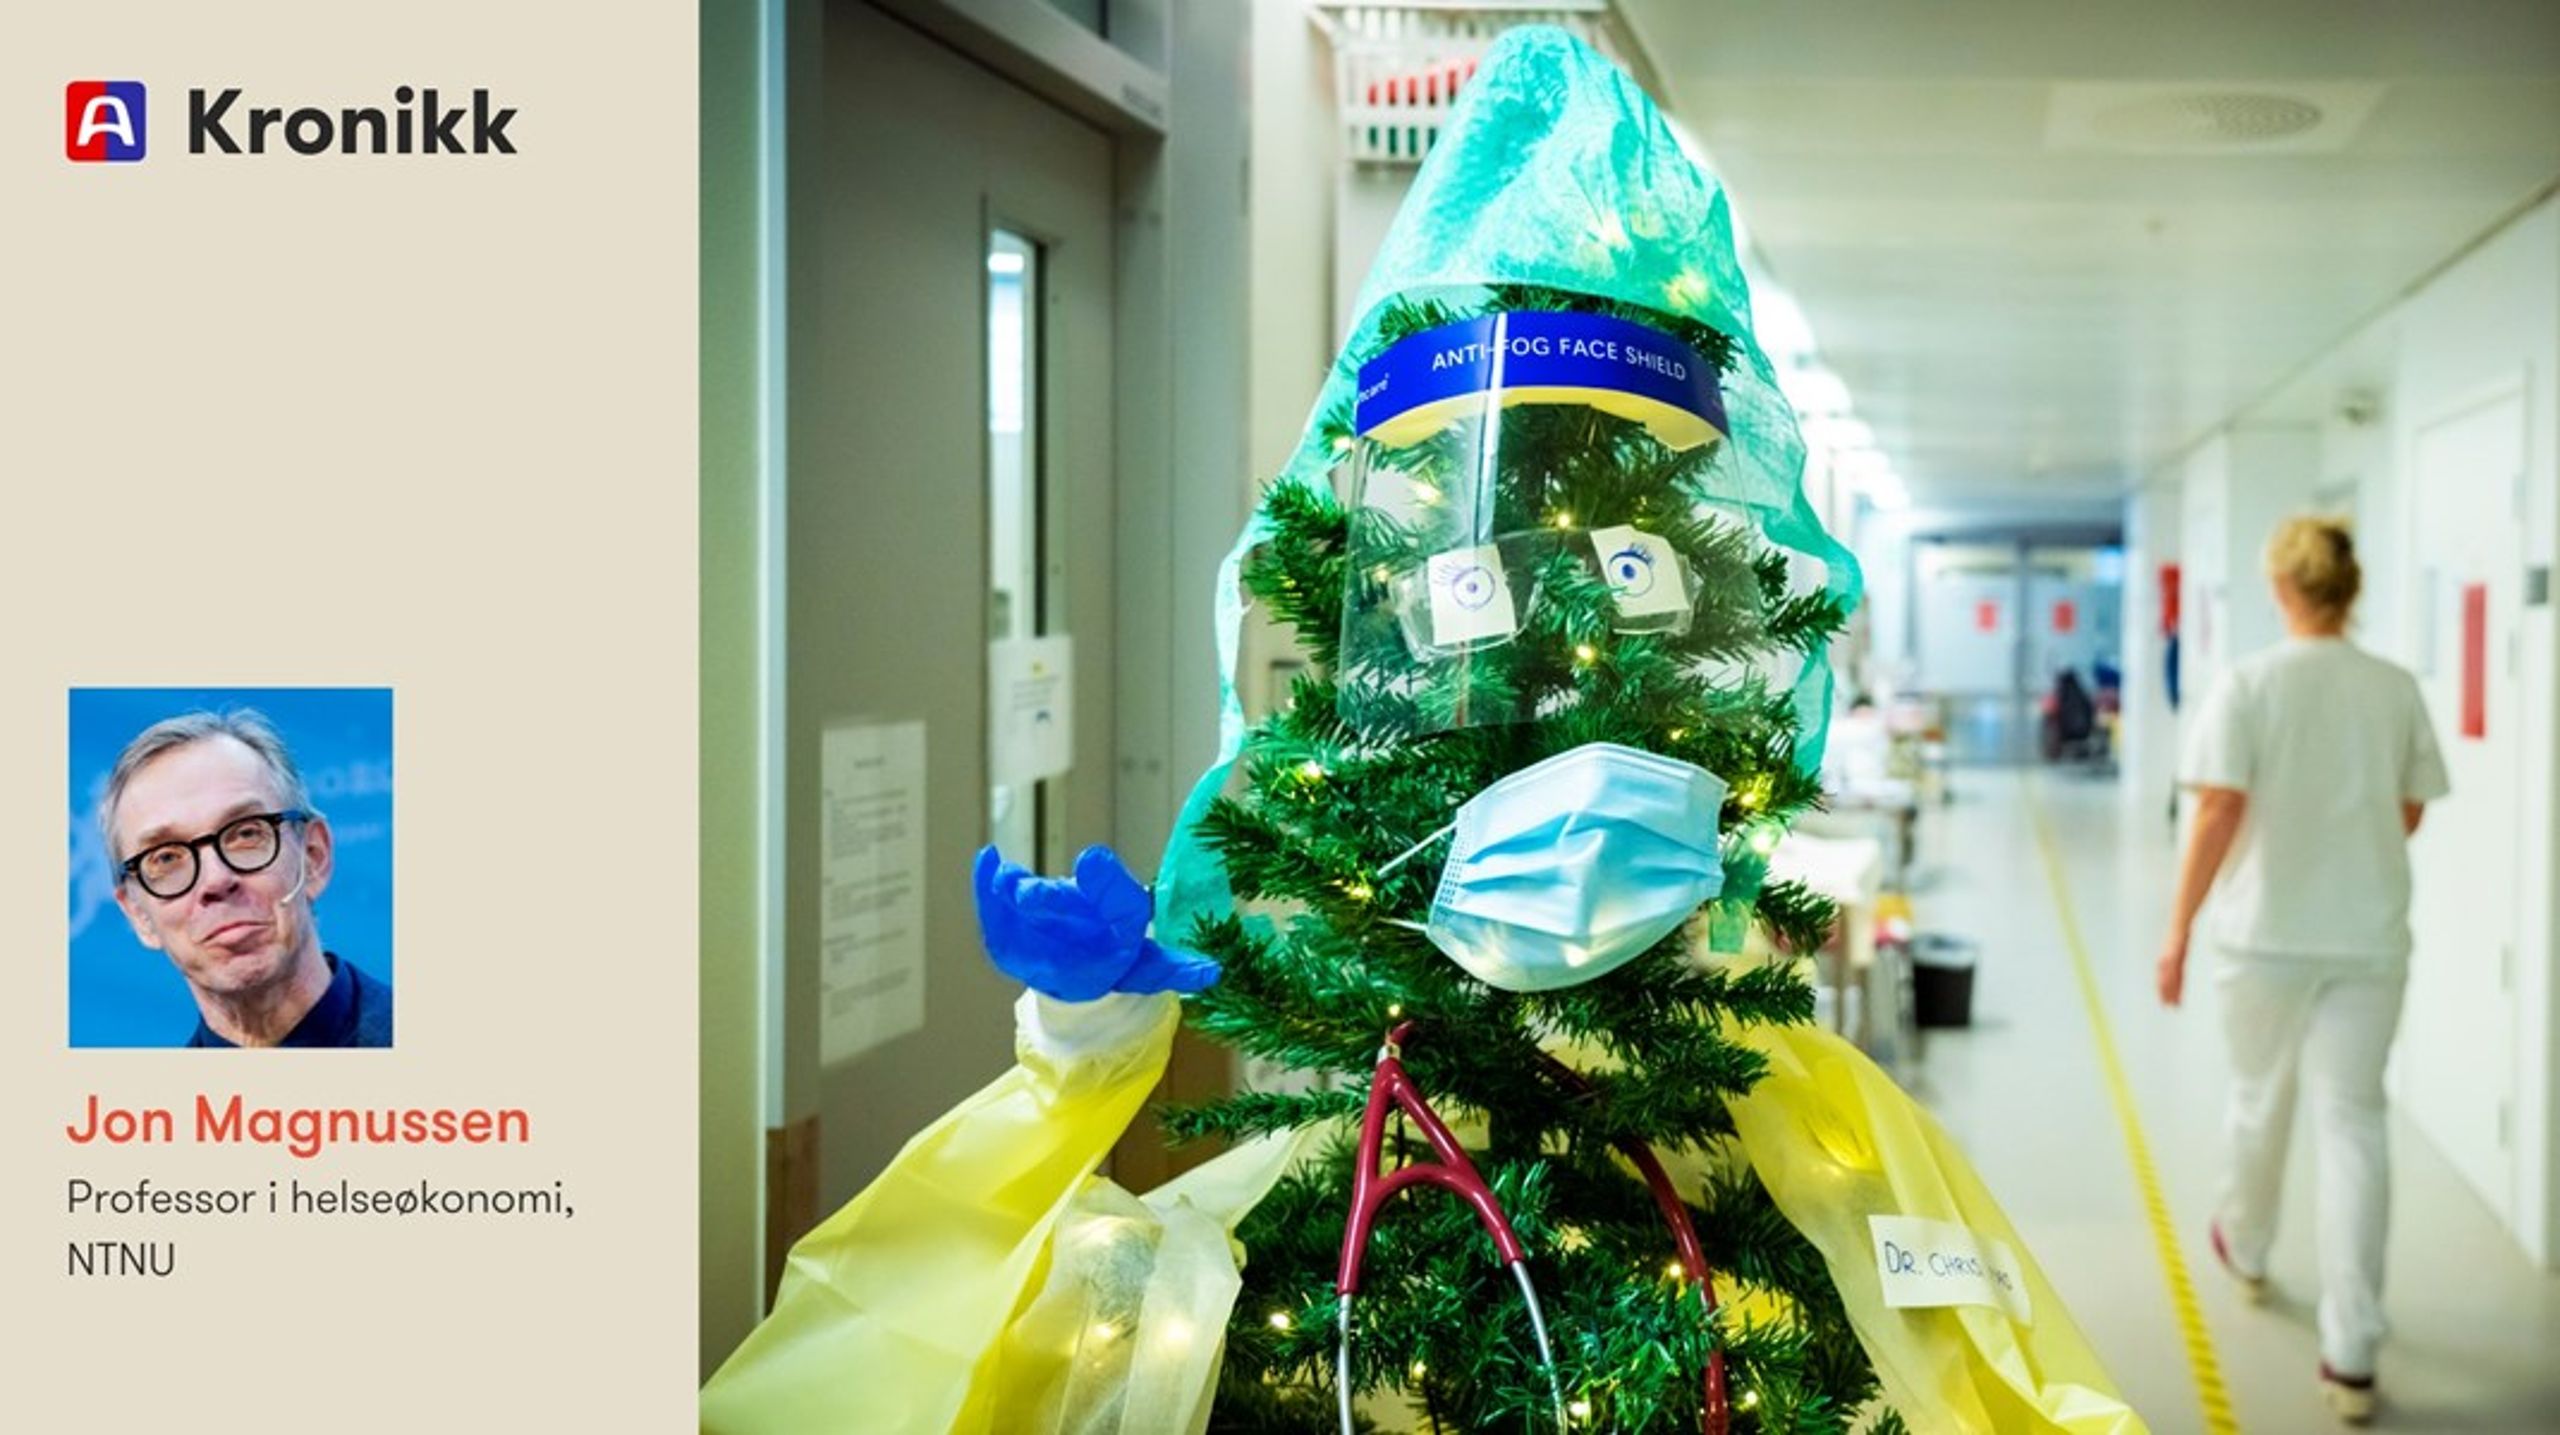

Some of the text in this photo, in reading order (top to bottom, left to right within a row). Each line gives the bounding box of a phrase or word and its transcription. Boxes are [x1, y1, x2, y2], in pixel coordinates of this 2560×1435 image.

[1432, 336, 1686, 381] ANTI-FOG FACE SHIELD
